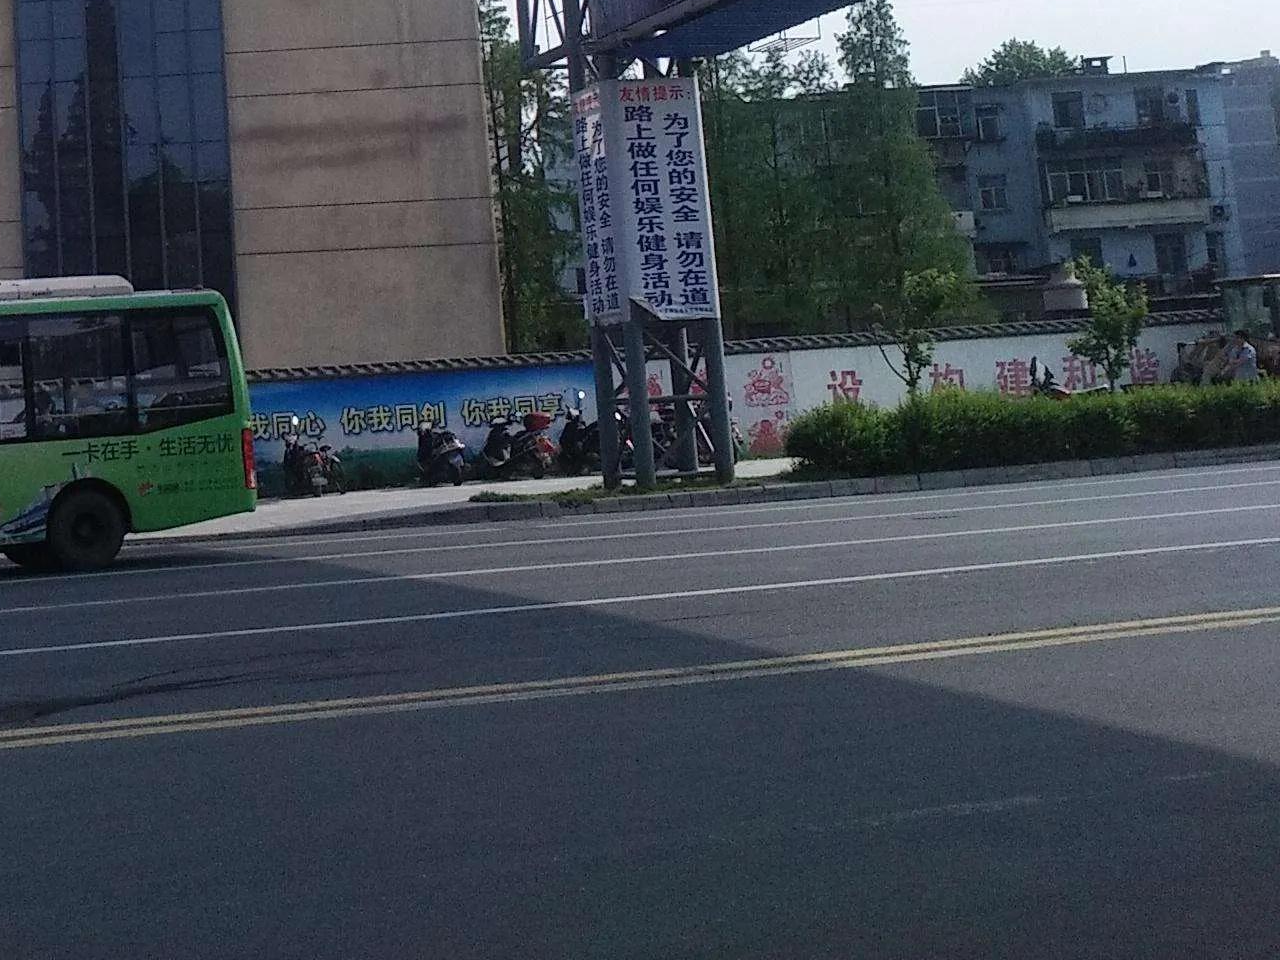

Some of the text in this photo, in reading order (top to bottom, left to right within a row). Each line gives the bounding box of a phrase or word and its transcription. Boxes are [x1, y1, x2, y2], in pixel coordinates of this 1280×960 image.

[624, 105, 672, 308] 路上做任何娱乐健身活动
[663, 112, 700, 223] 为了您的安全
[675, 231, 710, 306] 请勿在道
[340, 401, 446, 435] 你我同创
